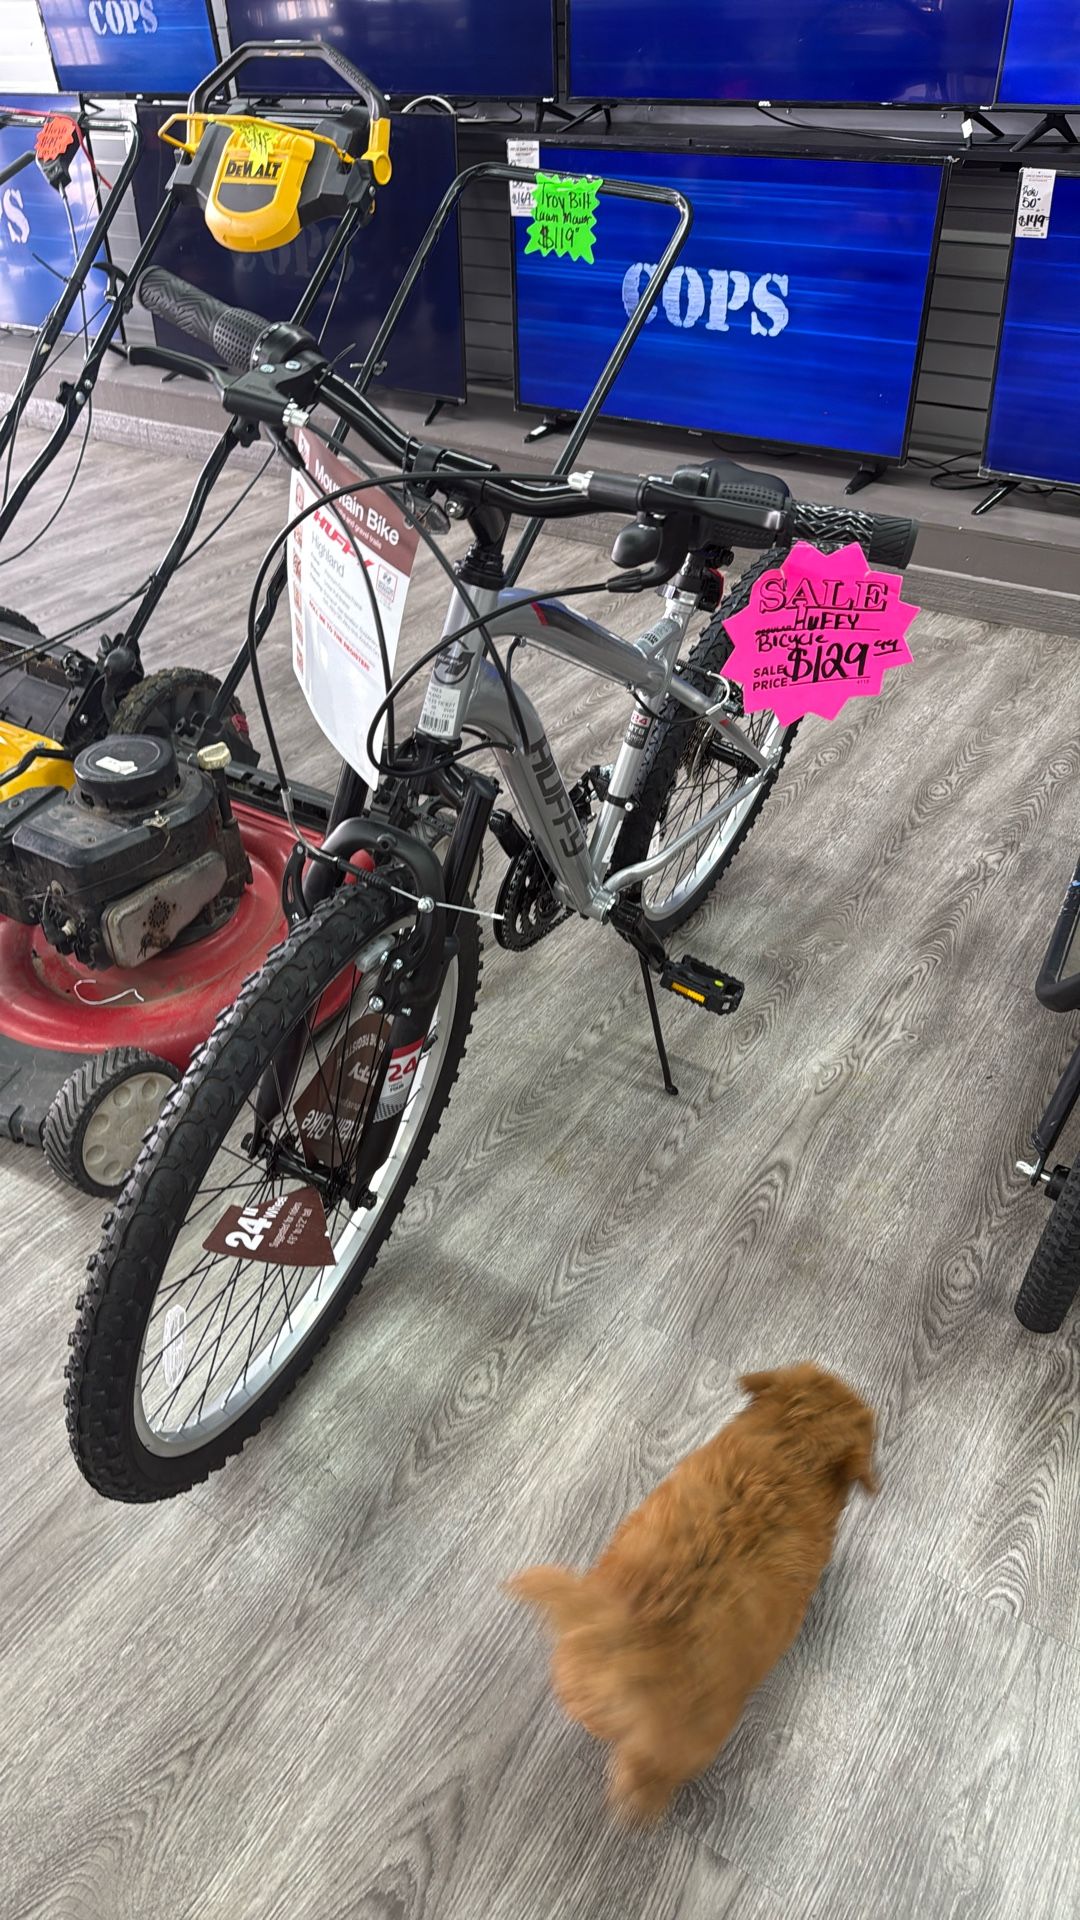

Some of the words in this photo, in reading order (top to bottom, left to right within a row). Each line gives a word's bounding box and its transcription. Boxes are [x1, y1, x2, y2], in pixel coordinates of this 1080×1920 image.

[88, 0, 158, 35] COPS
[537, 181, 565, 213] Troy
[537, 225, 575, 251] $119
[621, 262, 789, 337] COPS
[366, 507, 401, 546] Bike
[759, 577, 888, 614] SALE
[793, 602, 859, 631] HUFFY
[753, 664, 786, 678] SALE
[782, 641, 870, 683] $129
[752, 677, 788, 691] PRICE
[530, 735, 585, 858] HUFFY
[347, 1060, 380, 1087] FFY
[387, 1056, 418, 1083] 24
[301, 1109, 334, 1141] Bike
[225, 1206, 273, 1251] 24"
